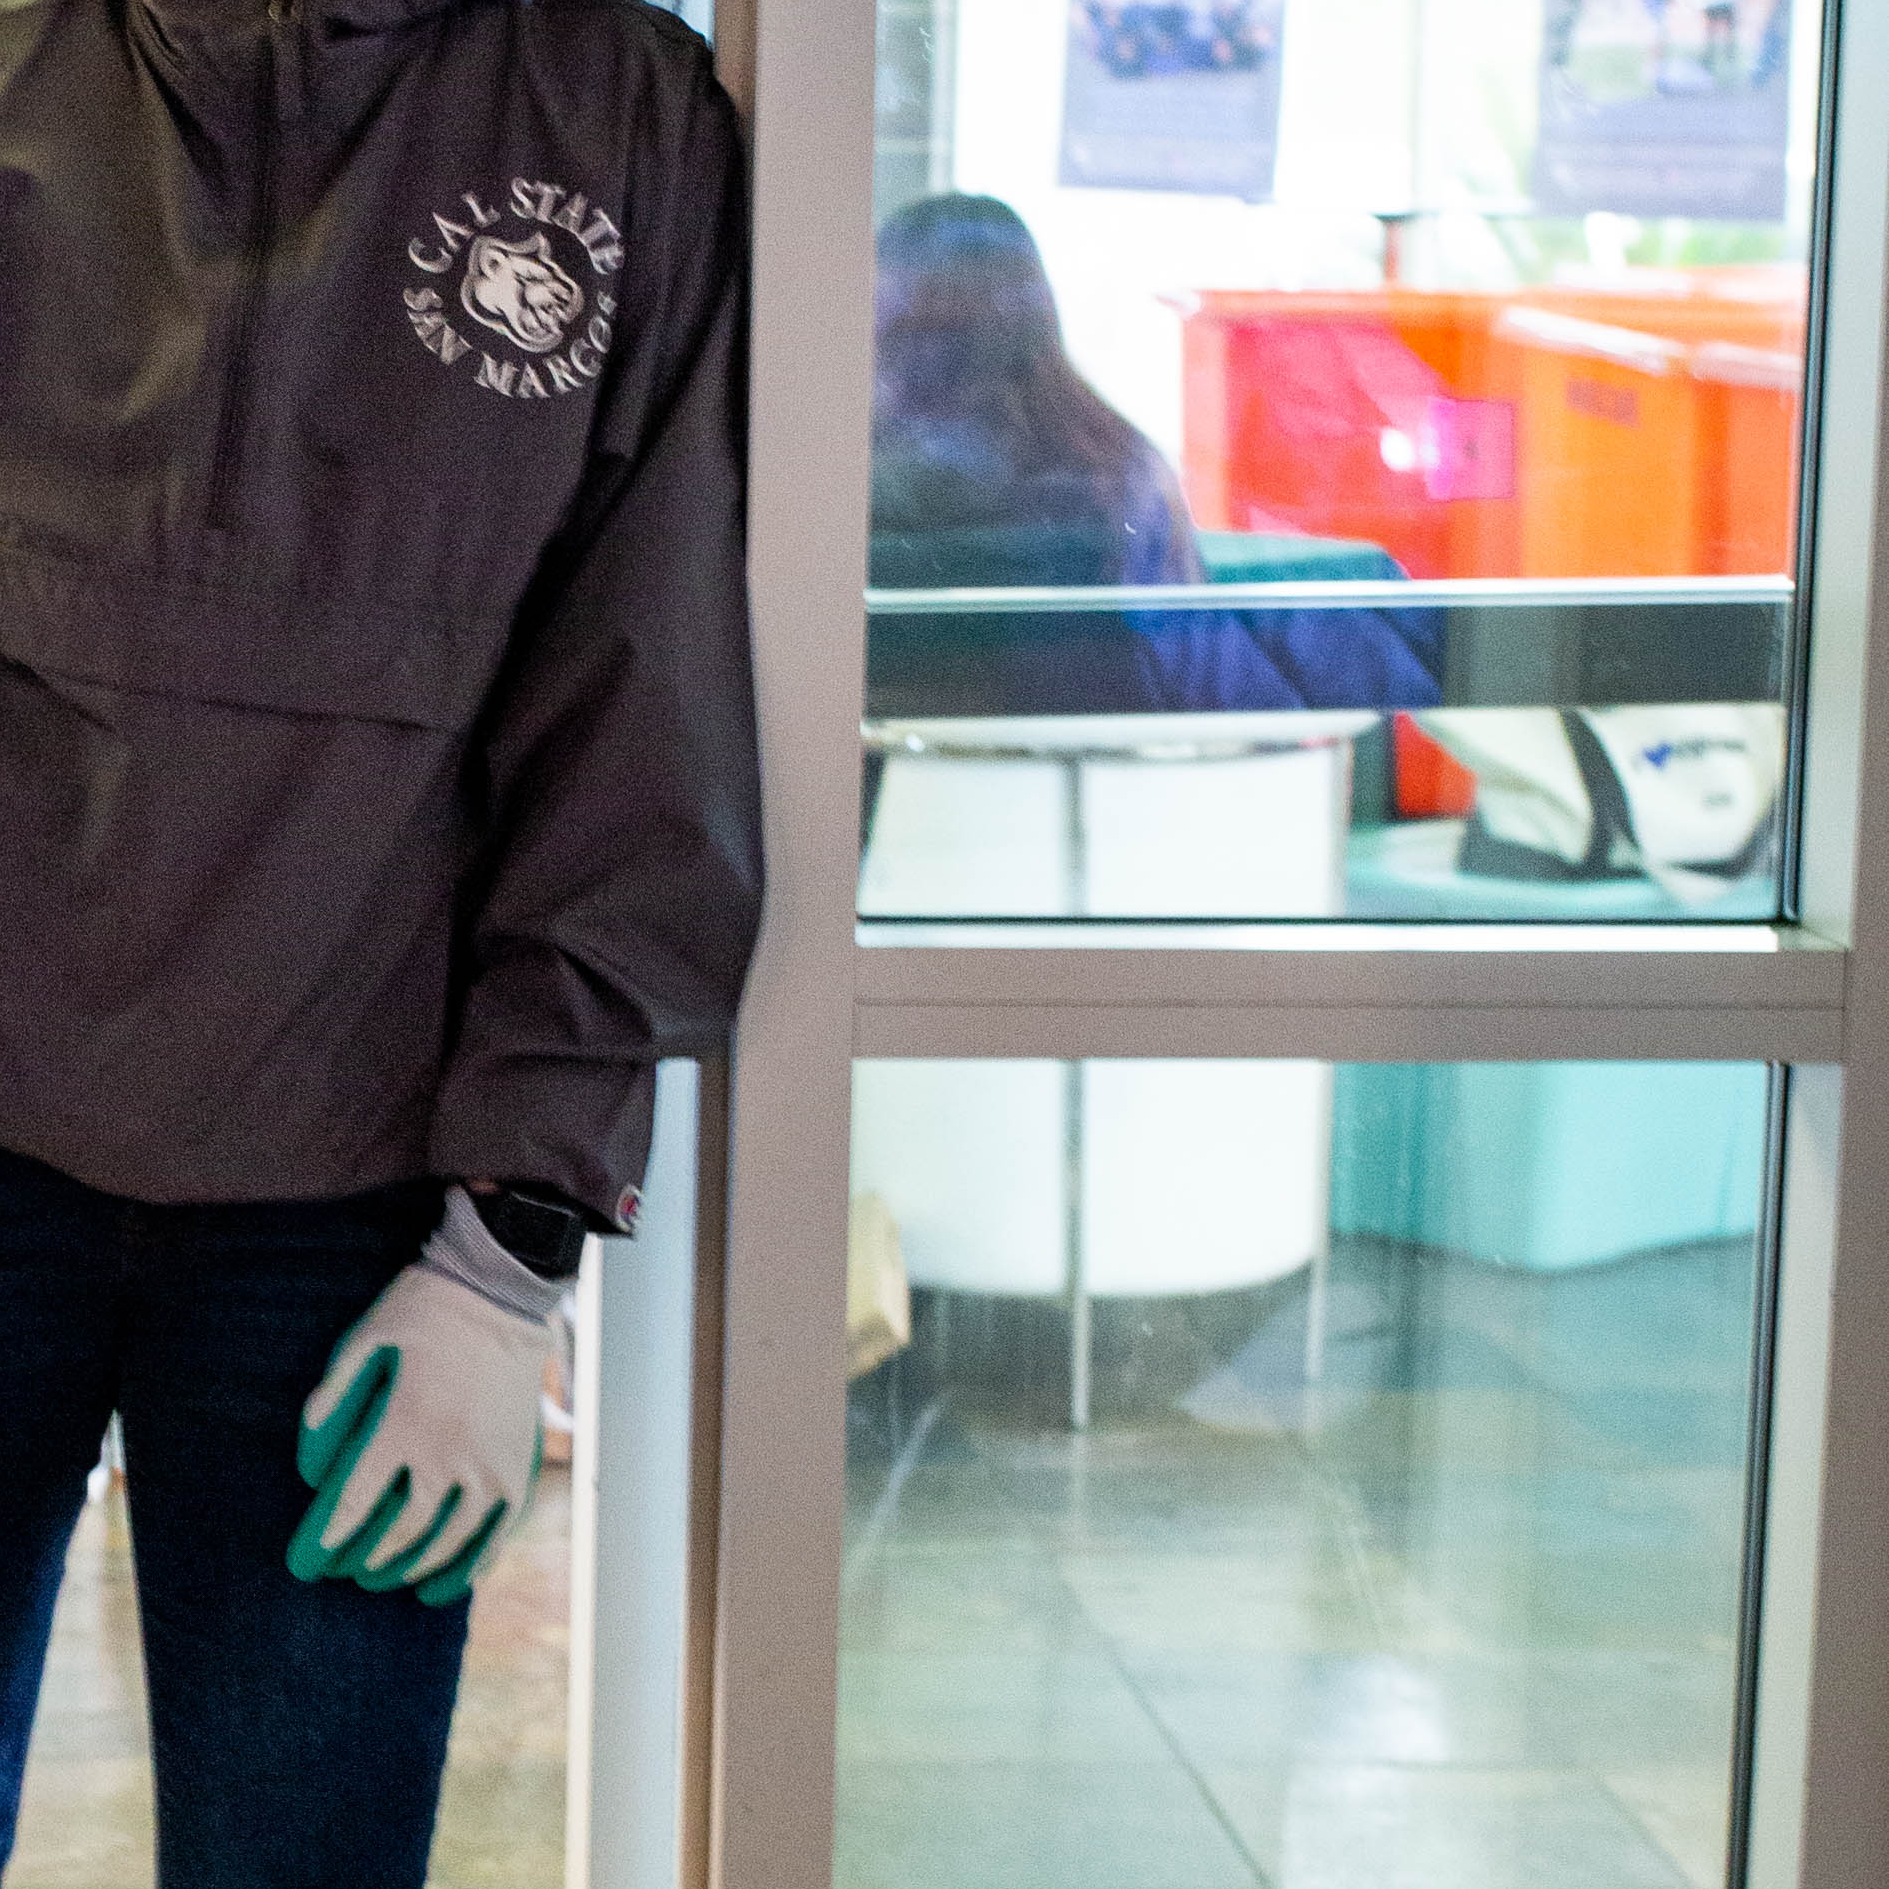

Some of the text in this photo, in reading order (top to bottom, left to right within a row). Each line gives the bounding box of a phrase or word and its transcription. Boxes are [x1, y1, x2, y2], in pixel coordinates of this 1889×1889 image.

[408, 176, 624, 275] CAL STATE
[402, 287, 472, 365] SAN
